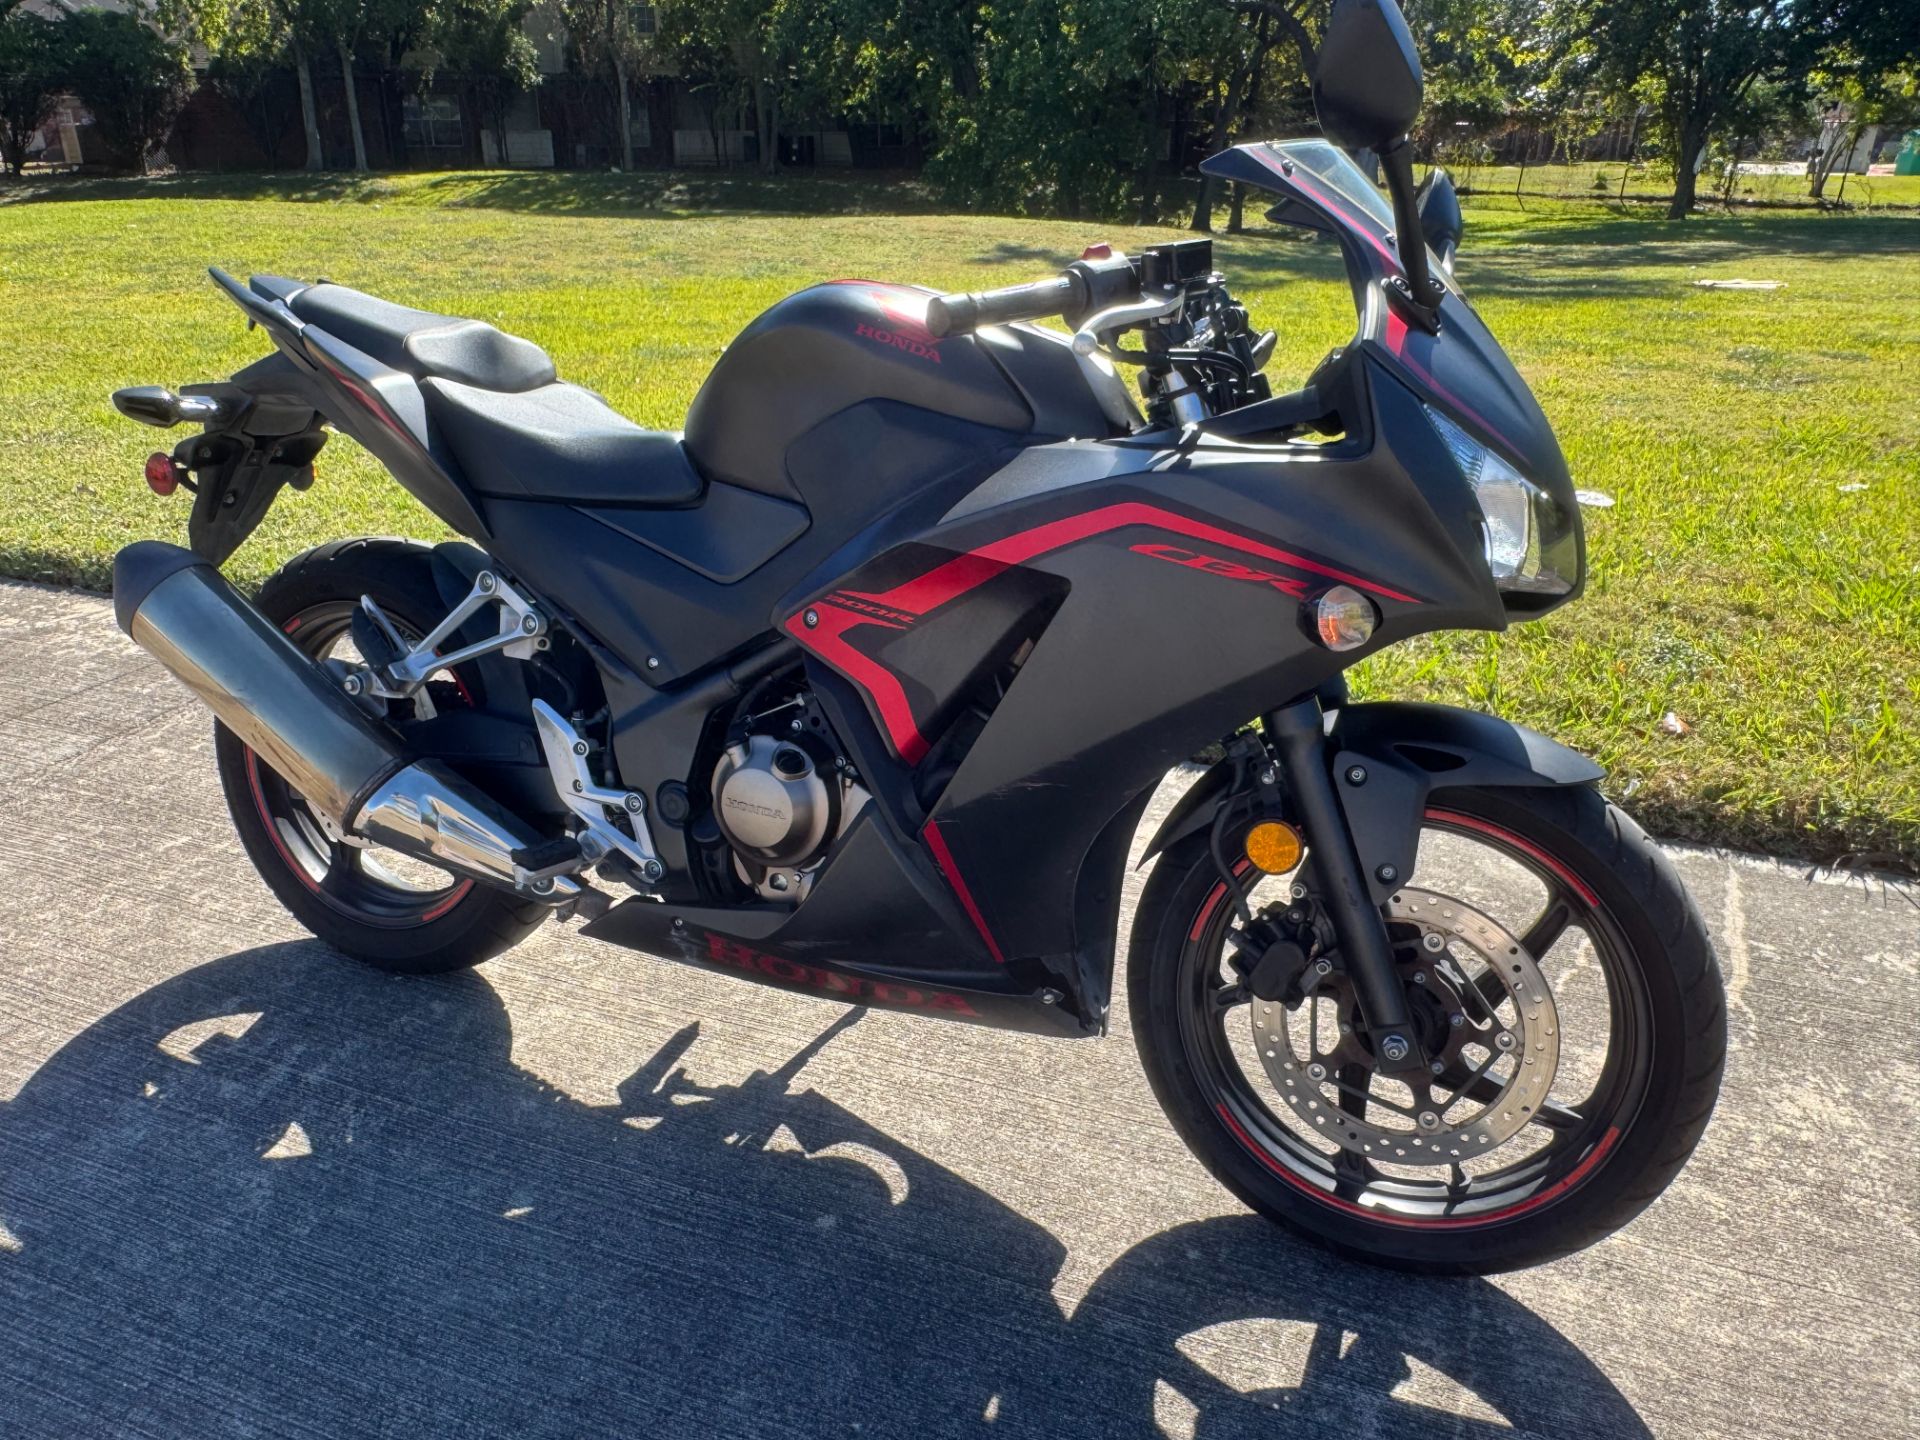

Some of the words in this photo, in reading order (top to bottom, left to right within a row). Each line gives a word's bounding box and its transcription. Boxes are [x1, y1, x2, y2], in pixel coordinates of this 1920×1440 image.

[855, 322, 942, 364] HONDA
[1129, 544, 1310, 599] CBR
[725, 797, 787, 820] HONDA
[704, 931, 980, 1017] HONDA
